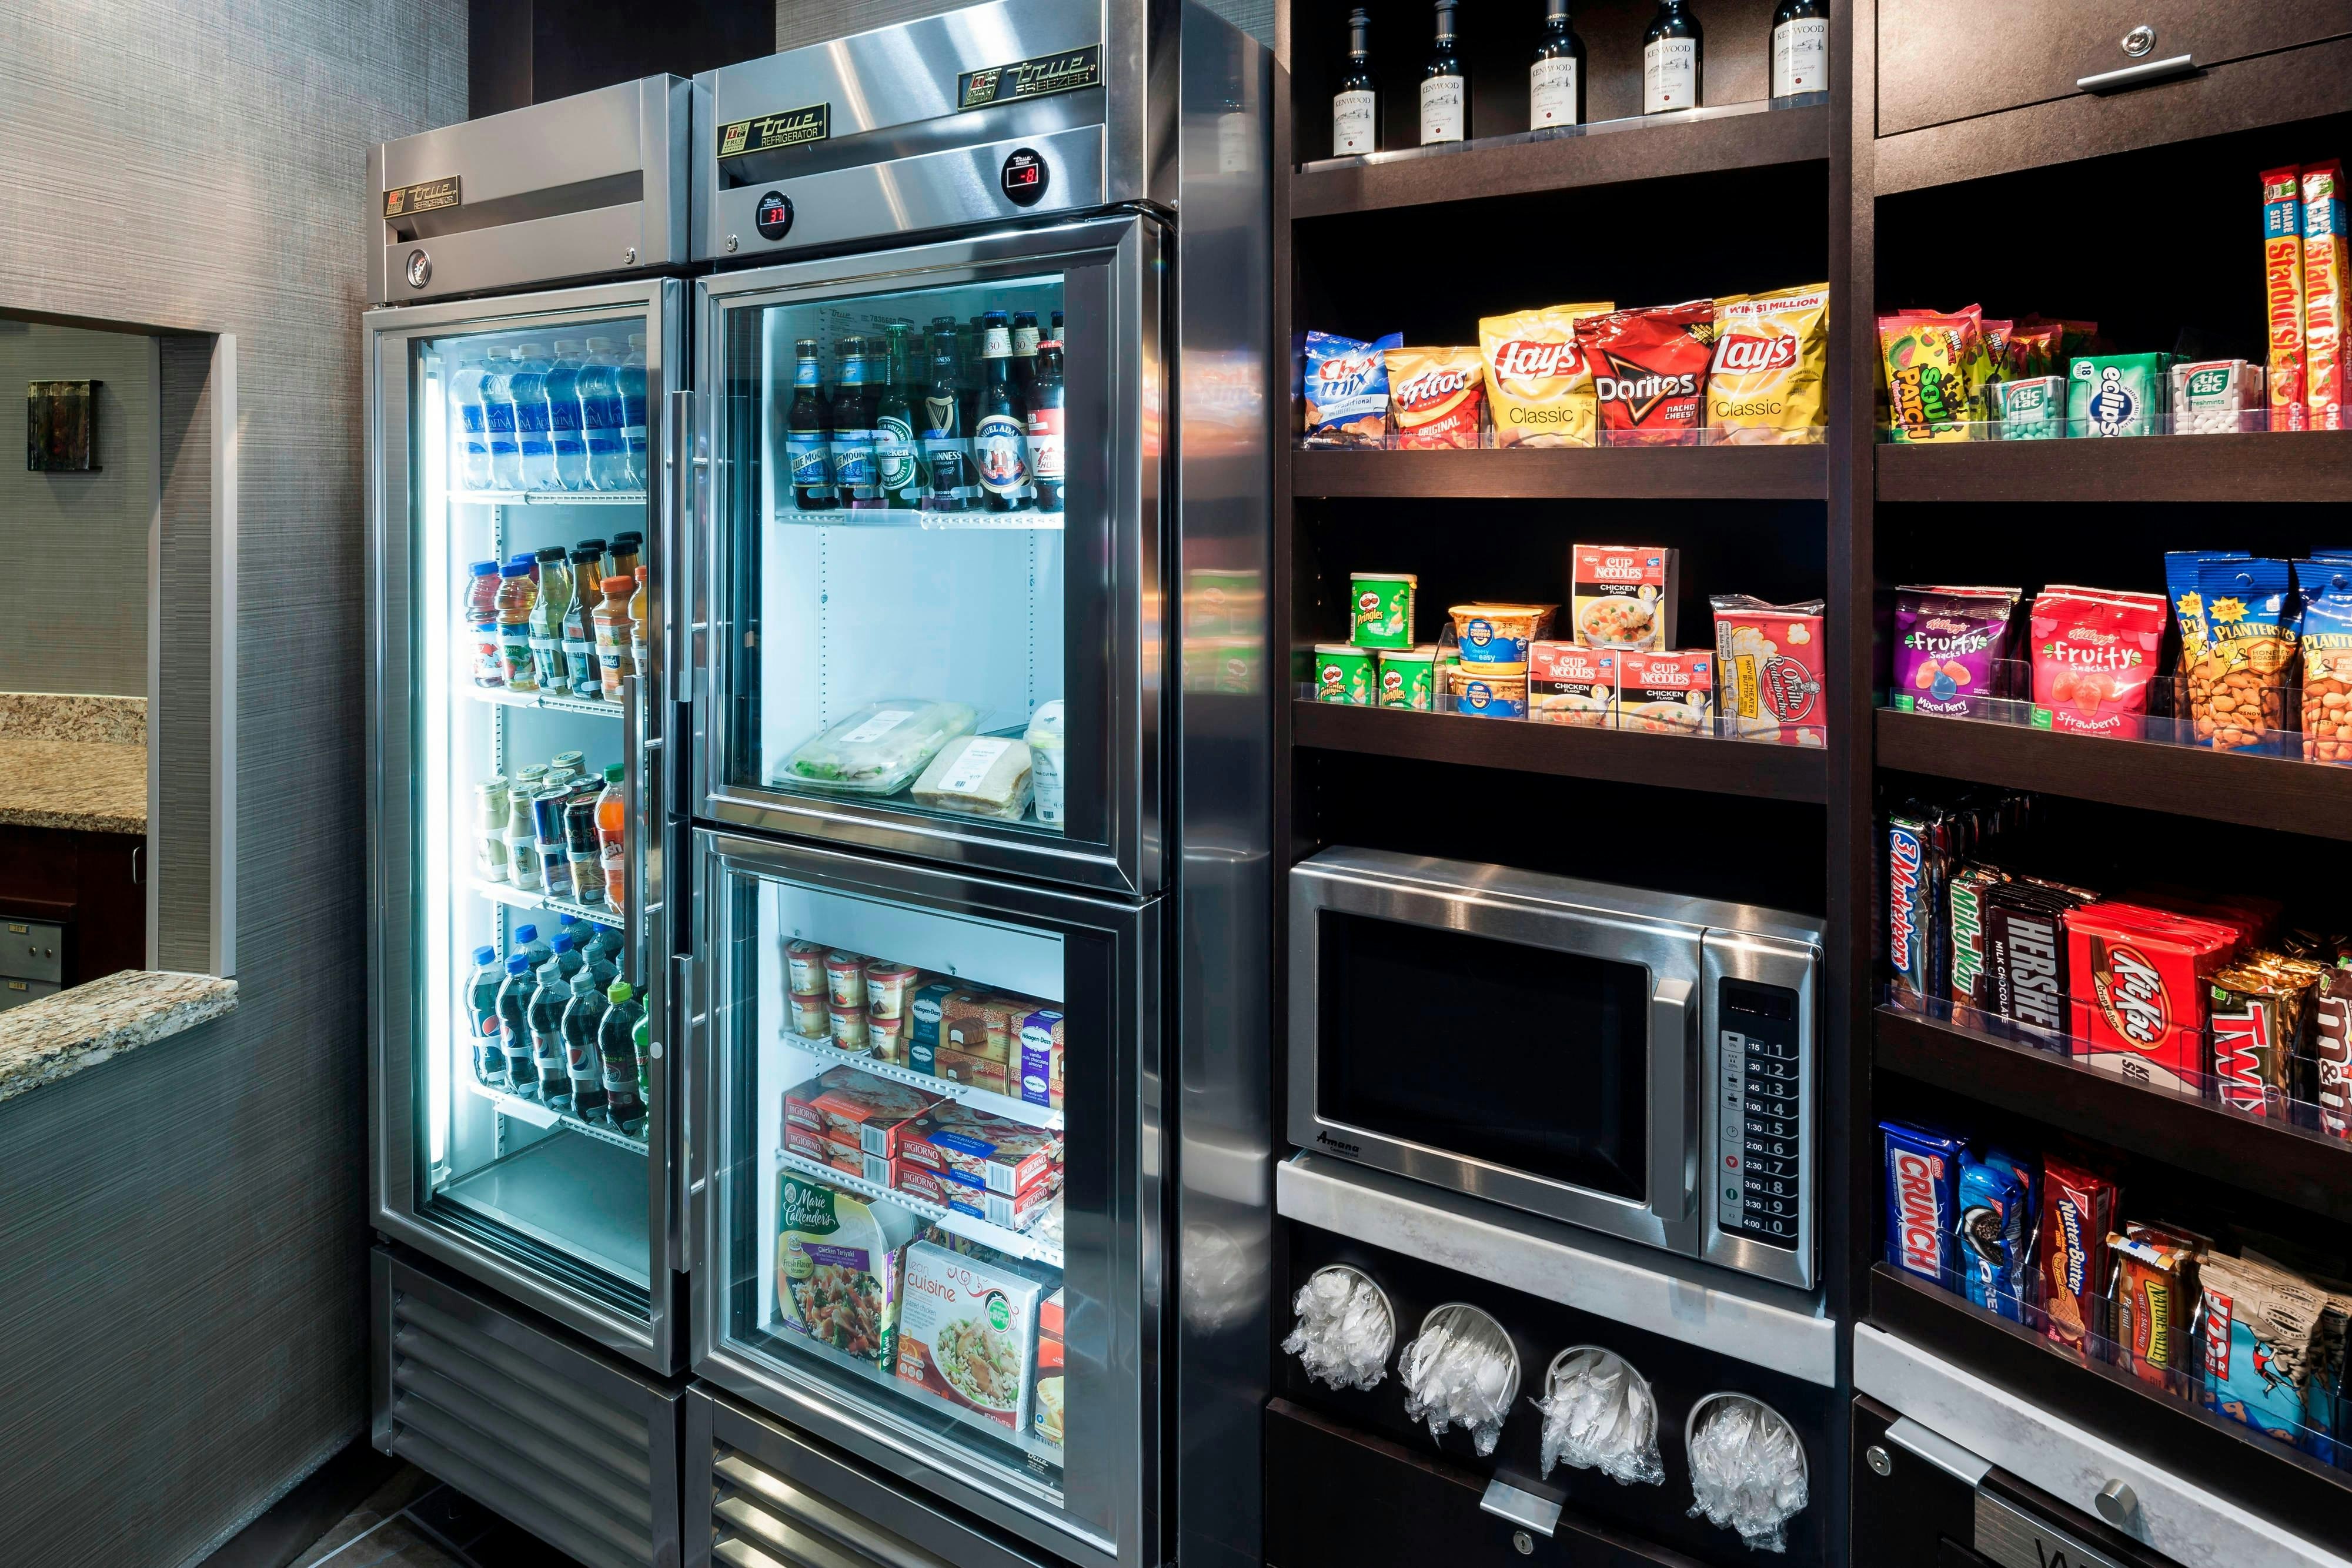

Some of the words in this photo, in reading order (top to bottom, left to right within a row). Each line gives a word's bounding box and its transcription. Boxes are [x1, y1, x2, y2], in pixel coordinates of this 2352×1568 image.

[1647, 45, 1690, 59] KENWOOD
[1532, 63, 1572, 78] KENWOOD
[1016, 73, 1089, 95] FREEZER
[1422, 82, 1459, 95] KENWOOD
[1335, 96, 1371, 108] KENWOOD
[761, 127, 818, 147] REFRIGERATOR
[413, 196, 454, 210] REFRIGERATOR
[2270, 209, 2281, 230] SIZE
[2282, 202, 2294, 233] SHARE
[1756, 303, 1767, 312] $1
[1769, 297, 1819, 310] MILLION
[2268, 241, 2304, 352] Starburst
[988, 341, 1000, 351] 30
[1949, 330, 1963, 351] SOUR
[2082, 365, 2092, 376] 18
[2199, 372, 2224, 383] tic
[1396, 369, 1468, 412] Fritos
[1596, 374, 1695, 401] Doritos
[2020, 389, 2041, 400] tic
[2192, 382, 2222, 393] tac
[1666, 404, 1695, 413] NACHO
[1716, 399, 1782, 417] Classic
[1897, 367, 1930, 439] PATCH
[1920, 367, 1952, 432] SOUR
[2015, 398, 2040, 409] tac
[2099, 366, 2124, 437] eclips
[1509, 407, 1574, 424] Classic
[887, 423, 906, 442] HOLLAND
[1418, 415, 1461, 436] ORIGINAL
[890, 466, 907, 482] QUALITY
[1605, 557, 1634, 569] CUP
[1594, 566, 1643, 580] NOODLES
[1357, 609, 1384, 628] Pringles
[1913, 631, 1981, 655] fruity
[1478, 654, 1496, 663] easy
[1559, 656, 1588, 668] CUP
[1929, 650, 1961, 660] Snacks
[2053, 641, 2134, 670] fruity
[1549, 664, 1596, 680] NOODLES
[1651, 662, 1680, 674] CUP
[1745, 660, 1753, 680] MOVIE
[2070, 663, 2110, 673] Snacks
[1555, 683, 1589, 691] CHICKEN
[1639, 671, 1690, 686] NOODLES
[1320, 682, 1346, 699] Pringles
[1382, 687, 1406, 703] Pringles
[1646, 690, 1684, 698] CHICKEN
[1782, 668, 1800, 710] Orville
[1917, 697, 1943, 712] Mixed
[1945, 700, 1967, 713] Berry
[2056, 711, 2121, 730] Strawberry
[1893, 833, 1916, 860] 3
[1950, 884, 1981, 951] Milky
[1995, 940, 2004, 965] MILK
[1952, 947, 1984, 994] Way
[2113, 950, 2160, 999] Kit
[1997, 966, 2009, 1024] CHOCOLATE
[2104, 1005, 2120, 1029] Wafers
[2115, 987, 2162, 1043] Kat
[1775, 1044, 1782, 1056] 1
[1775, 1064, 1784, 1076] 2
[1774, 1084, 1783, 1095] 3
[1745, 1102, 1761, 1112] 1:00
[1773, 1103, 1784, 1115] 4
[1746, 1122, 1762, 1132] 1:30
[1775, 1122, 1783, 1135] 5
[1317, 1131, 1360, 1153] Amana
[1746, 1141, 1762, 1151] 2:00
[1773, 1142, 1783, 1155] 6
[1746, 1161, 1762, 1170] 2:30
[1774, 1162, 1783, 1174] 7
[1745, 1181, 1761, 1190] 3:00
[1773, 1181, 1783, 1193] 8
[795, 1189, 826, 1211] Marie
[1745, 1200, 1761, 1209] 3:30
[1773, 1201, 1783, 1213] 9
[783, 1201, 836, 1227] Callender's
[1899, 1155, 1937, 1274] CRUNCH
[1744, 1219, 1760, 1229] 4:00
[1773, 1221, 1783, 1233] 0
[2059, 1199, 2080, 1250] Nutter
[818, 1245, 836, 1255] Chicken
[837, 1248, 855, 1258] Teriyaki
[783, 1258, 796, 1268] Fresh
[796, 1261, 811, 1269] Flavor
[908, 1256, 930, 1276] lean
[2068, 1248, 2085, 1296] Butter
[907, 1272, 956, 1303] cuisine
[1979, 1259, 1998, 1313] ORE
[904, 1298, 919, 1309] glazed
[919, 1302, 937, 1316] chicken
[2137, 1292, 2147, 1312] SWEET
[2148, 1283, 2169, 1330] NATURE
[2122, 1296, 2132, 1329] Peanut
[2267, 1310, 2304, 1330] ORGANIC
[2139, 1316, 2147, 1335] SALTY
[2205, 1291, 2229, 1358] CLIF
[2265, 1318, 2288, 1335] ROLLED
[2137, 1335, 2146, 1348] NUT
[2205, 1353, 2226, 1373] BAR
